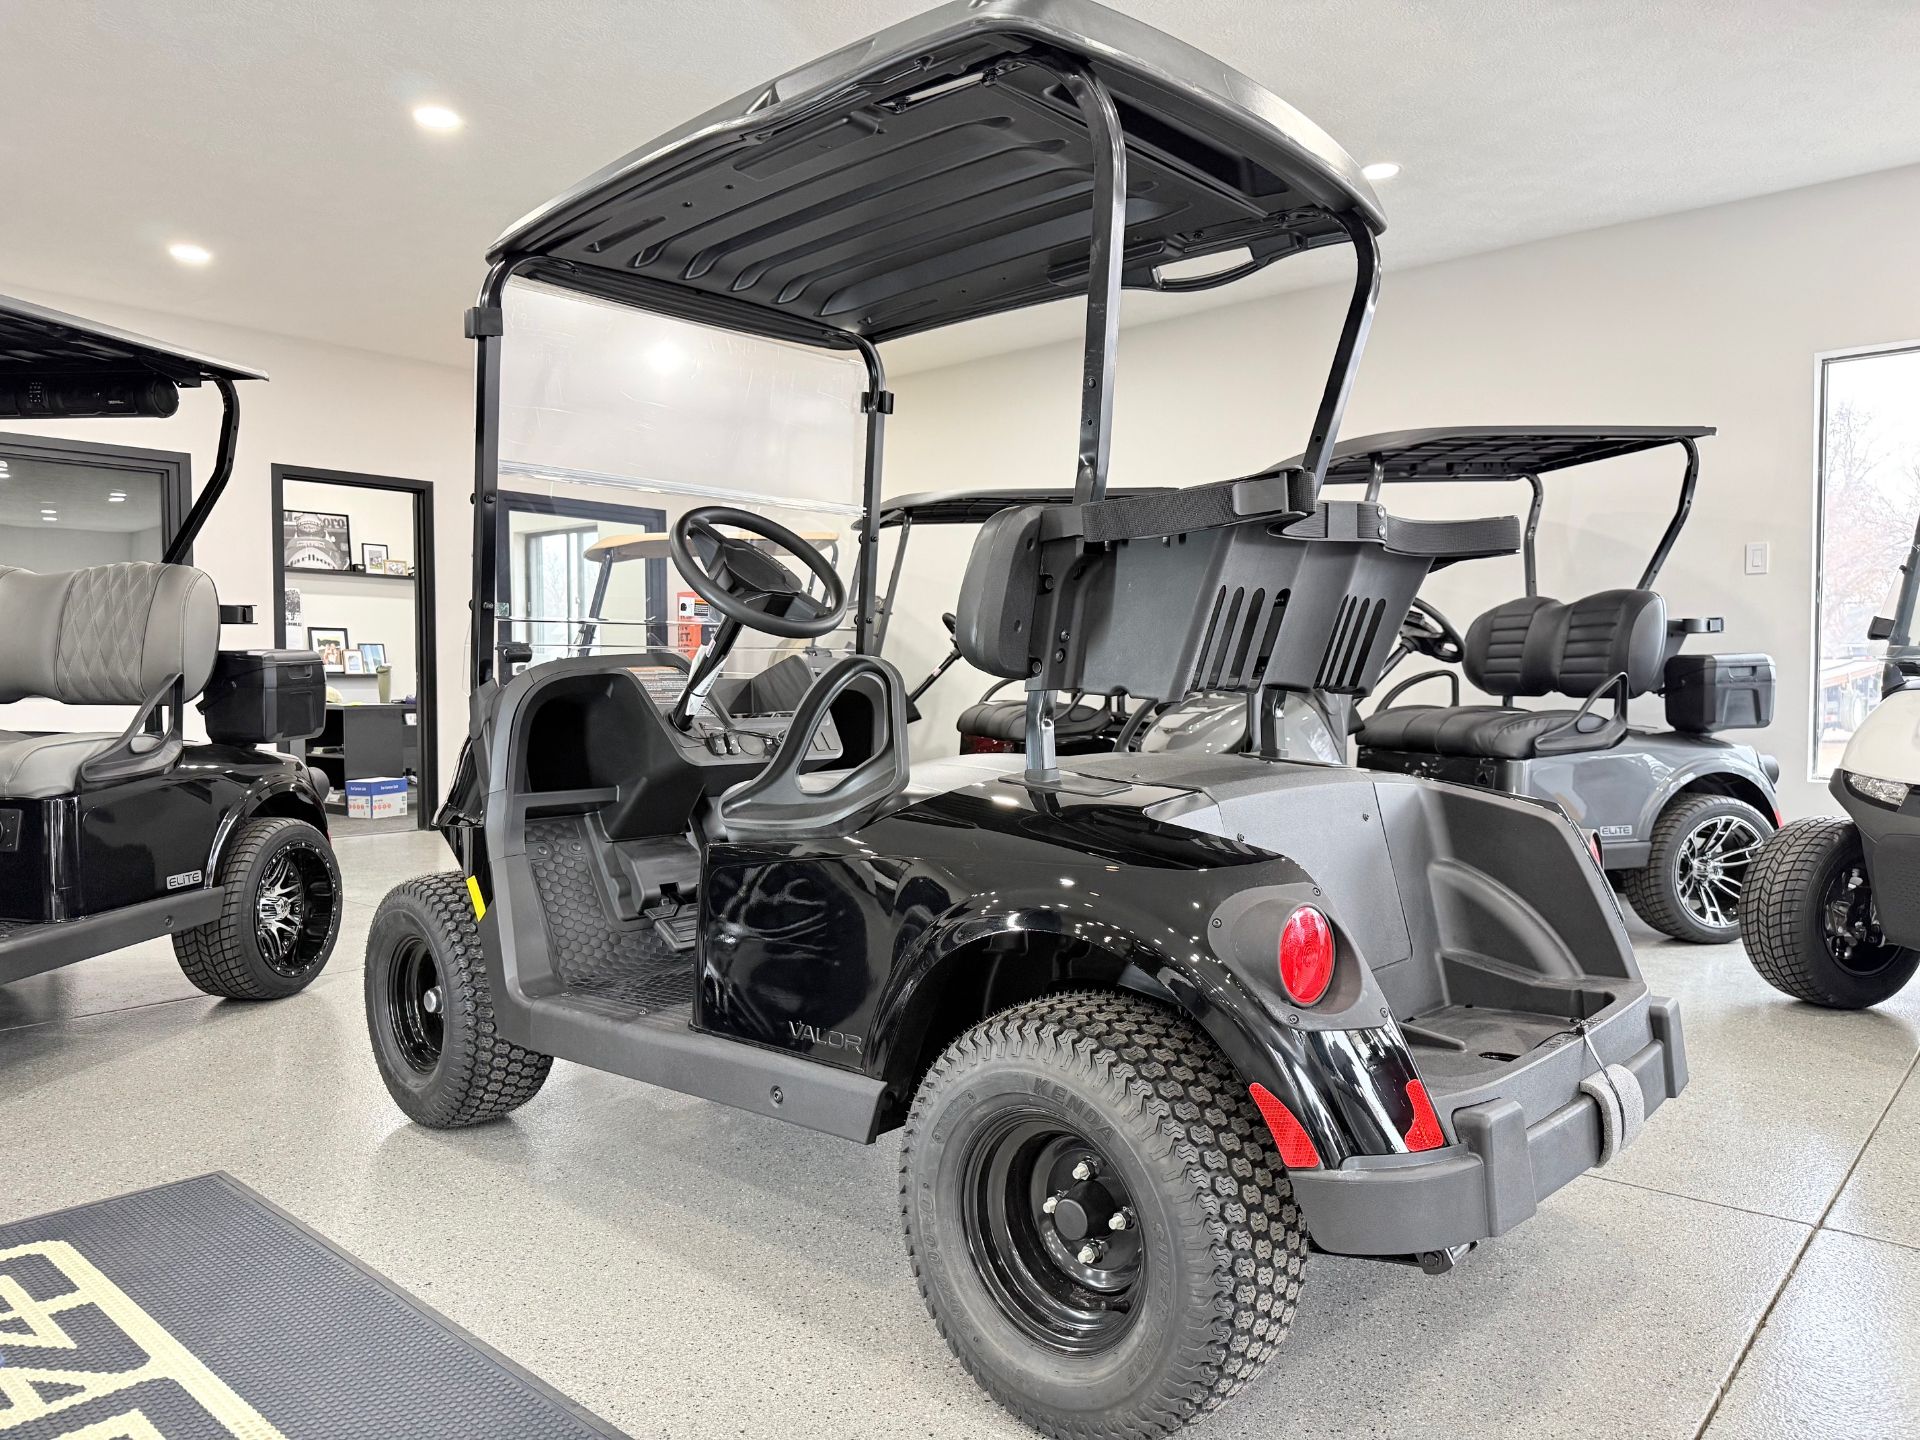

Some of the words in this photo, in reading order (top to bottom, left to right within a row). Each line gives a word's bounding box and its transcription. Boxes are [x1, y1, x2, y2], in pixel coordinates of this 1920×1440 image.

[788, 1020, 862, 1054] VALOR
[1033, 1077, 1115, 1144] KENDA
[1151, 1221, 1169, 1322] SUPER
